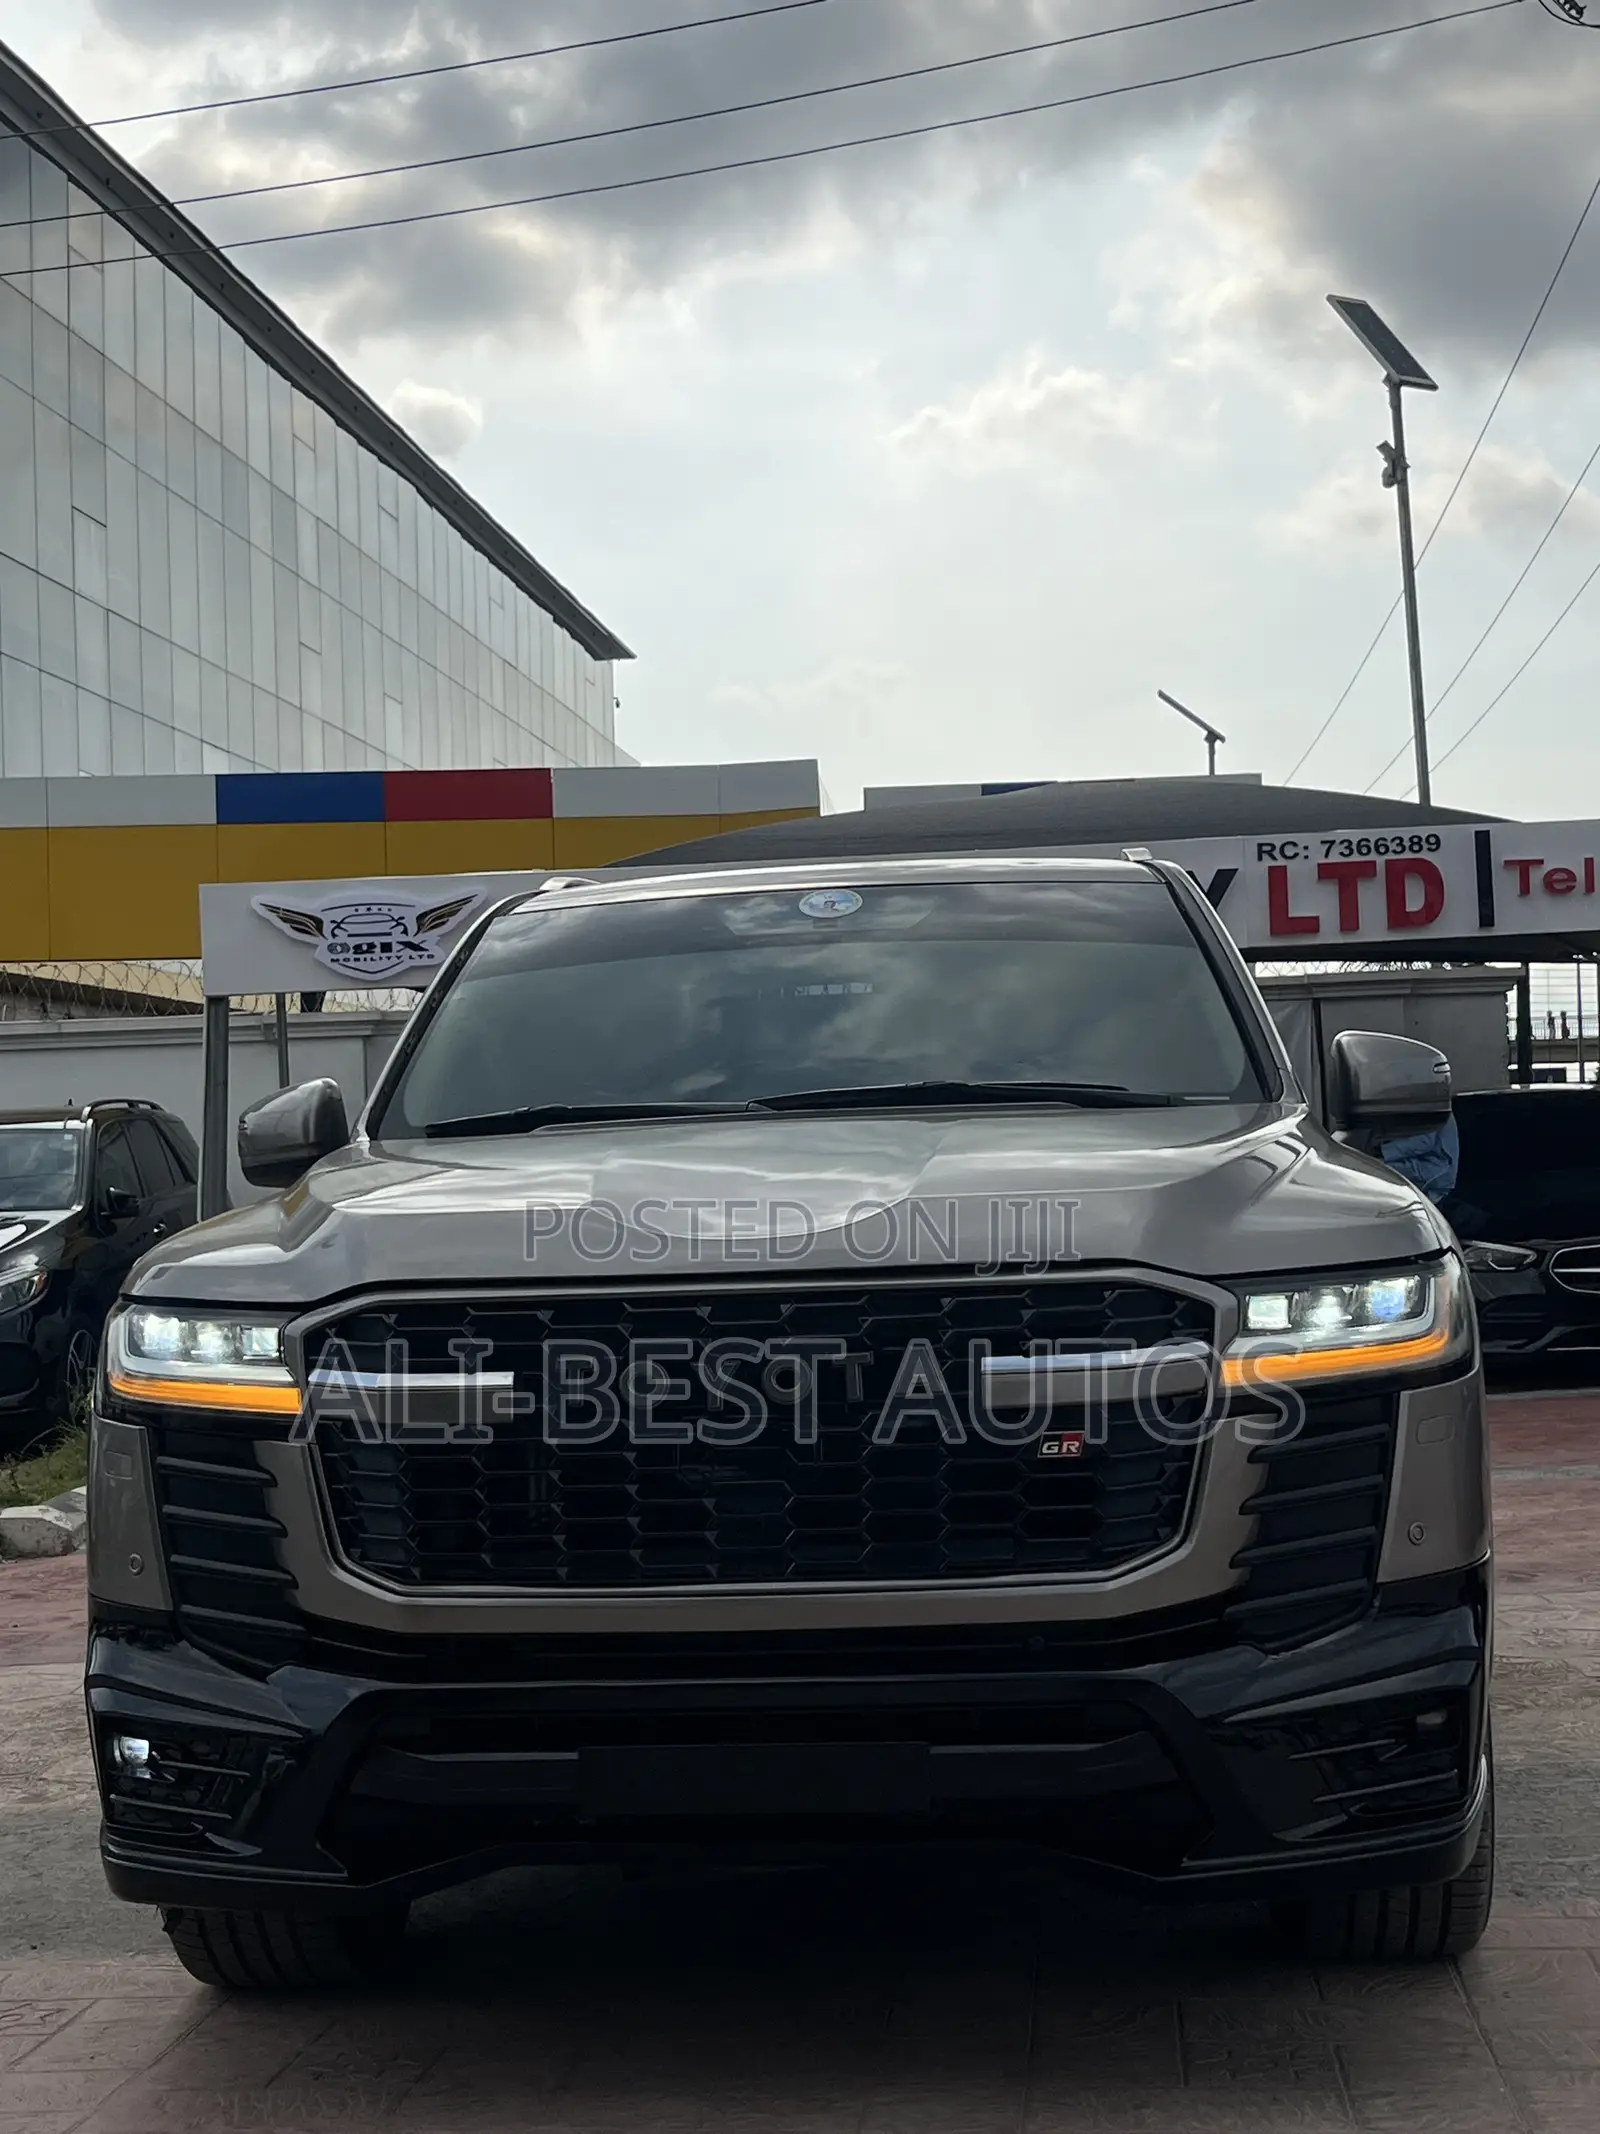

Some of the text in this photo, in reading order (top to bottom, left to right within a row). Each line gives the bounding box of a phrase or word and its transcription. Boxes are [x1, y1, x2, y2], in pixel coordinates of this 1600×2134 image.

[1256, 833, 1442, 862] RC: 7366389
[1503, 857, 1596, 896] Tel
[1268, 857, 1445, 937] LTD
[1040, 1438, 1082, 1456] GR
